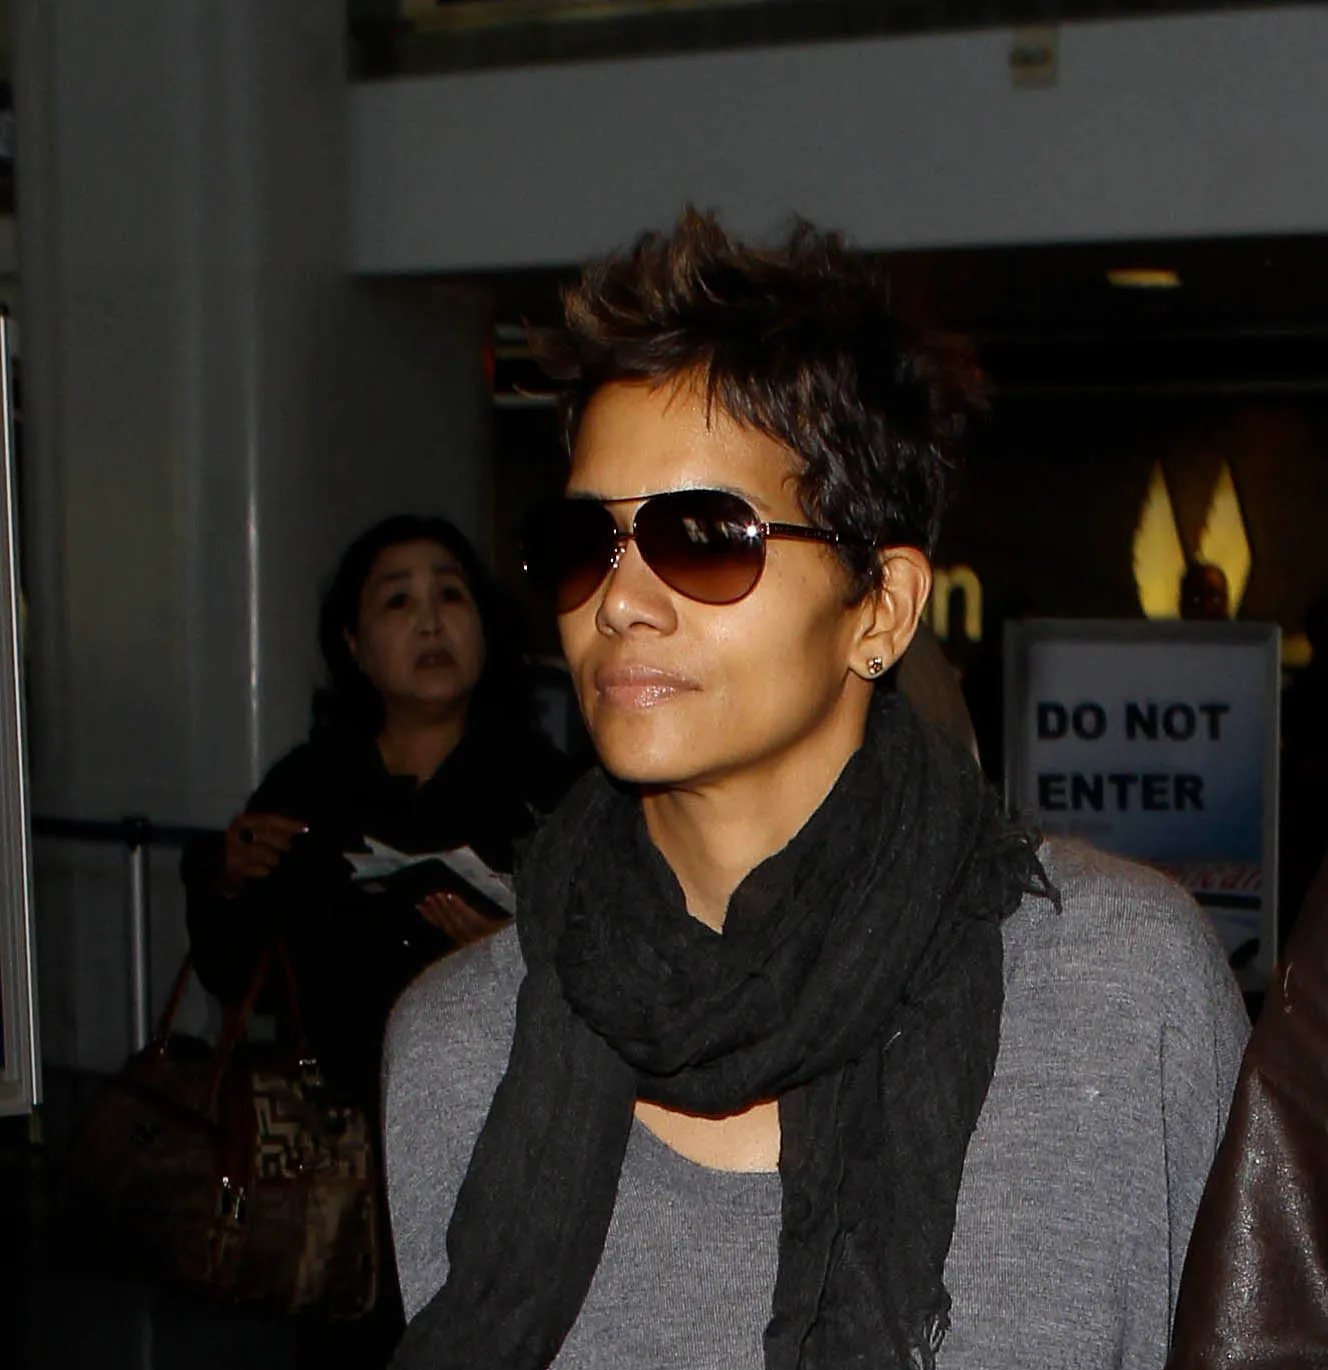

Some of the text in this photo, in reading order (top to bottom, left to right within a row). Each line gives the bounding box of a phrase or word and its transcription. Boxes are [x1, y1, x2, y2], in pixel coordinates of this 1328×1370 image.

[1037, 701, 1230, 741] DO NOT
[1037, 772, 1205, 811] ENTER
